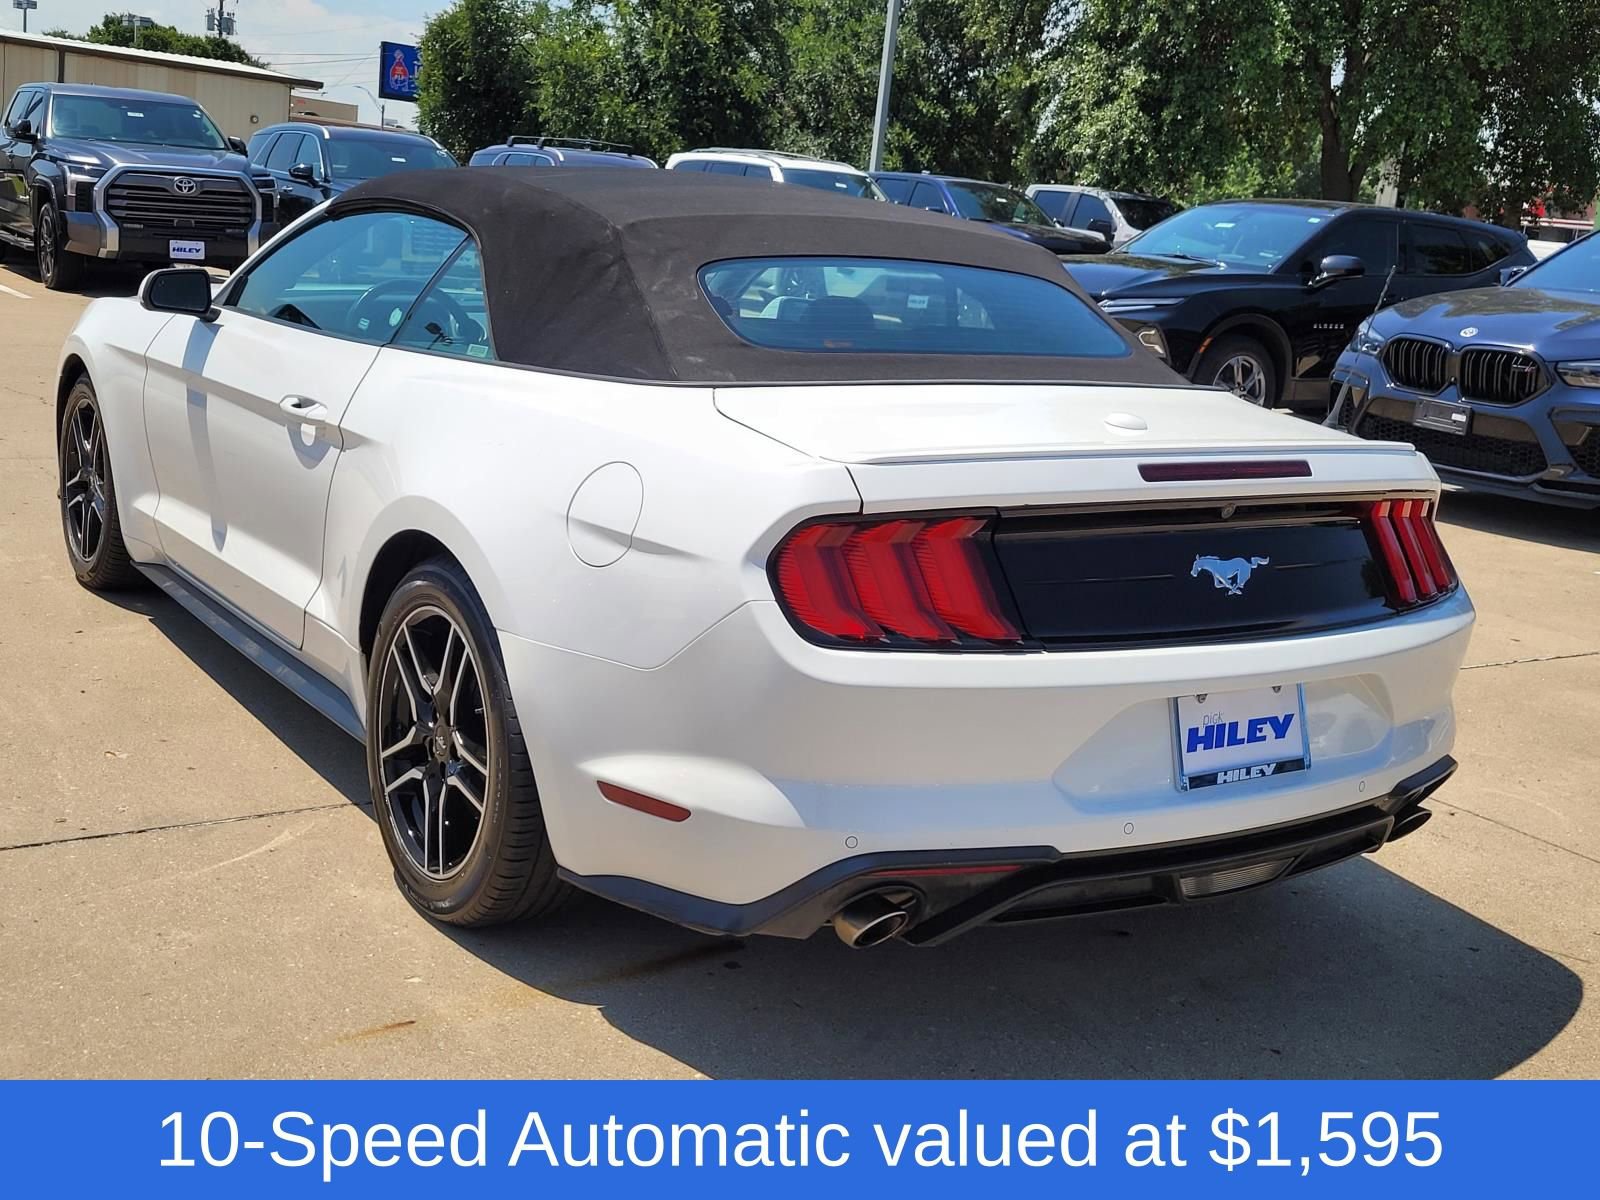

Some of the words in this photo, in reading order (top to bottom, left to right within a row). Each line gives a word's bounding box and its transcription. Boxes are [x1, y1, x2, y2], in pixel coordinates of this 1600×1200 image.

[172, 246, 202, 254] HILEY
[1186, 713, 1295, 753] HILEY
[1216, 763, 1277, 785] HILEY
